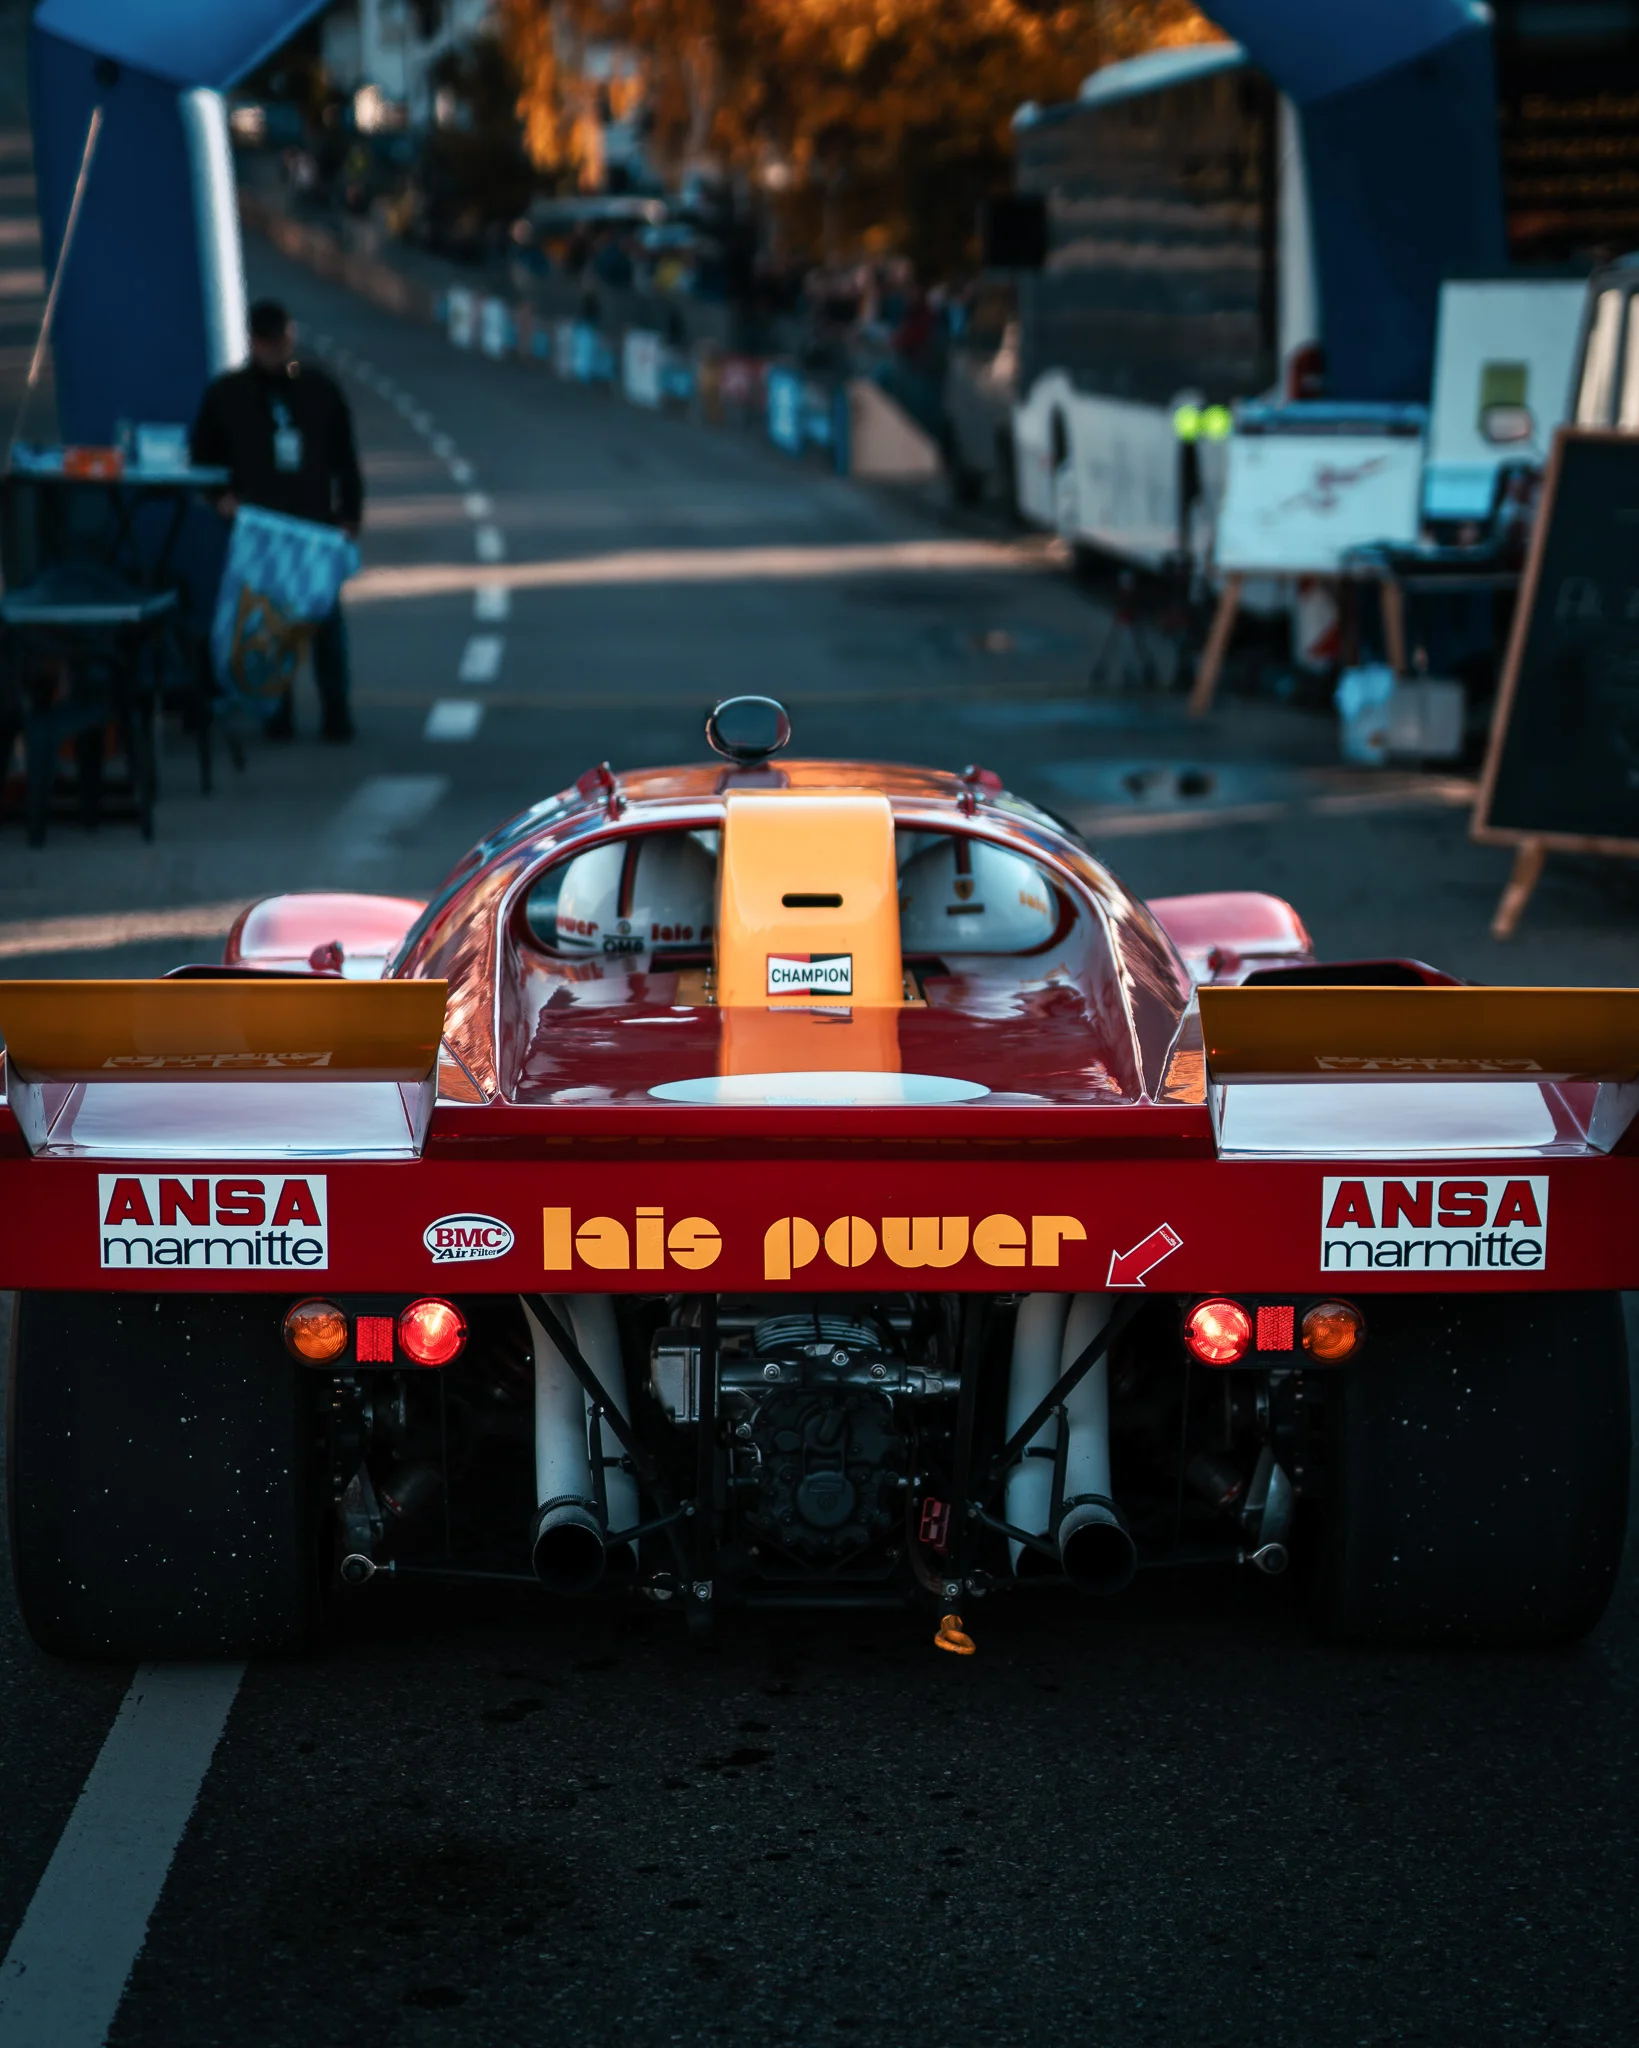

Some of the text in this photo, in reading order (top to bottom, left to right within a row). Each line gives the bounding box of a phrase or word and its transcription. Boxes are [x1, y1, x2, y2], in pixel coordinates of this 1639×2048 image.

[771, 967, 849, 983] CHAMPION
[103, 1177, 322, 1226] ANSA
[1325, 1179, 1542, 1229] ANSA
[103, 1230, 324, 1266] marmitte
[436, 1247, 498, 1260] Air Filter
[543, 1206, 1088, 1281] lais power
[1324, 1231, 1543, 1268] marmitte
